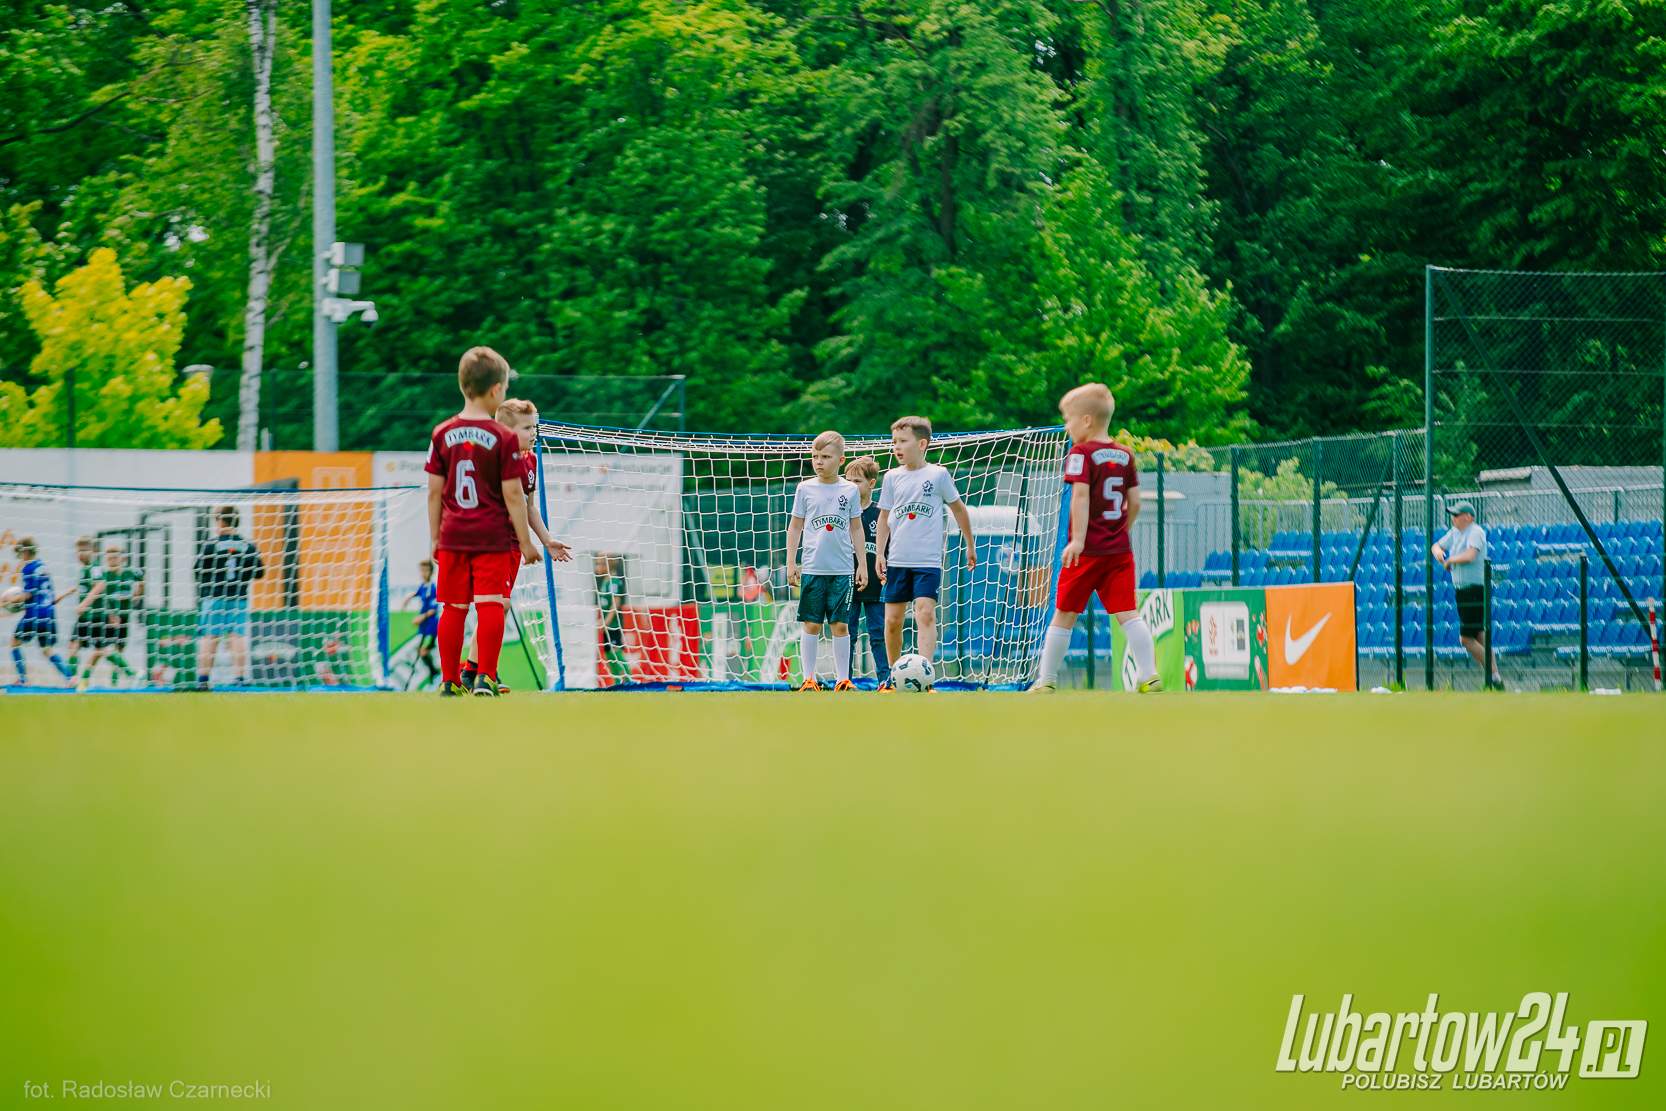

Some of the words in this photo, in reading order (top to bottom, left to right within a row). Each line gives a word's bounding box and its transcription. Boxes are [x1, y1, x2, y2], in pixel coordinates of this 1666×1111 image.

[455, 459, 479, 509] 6
[1103, 476, 1124, 520] 5
[814, 516, 845, 528] TYMBARK
